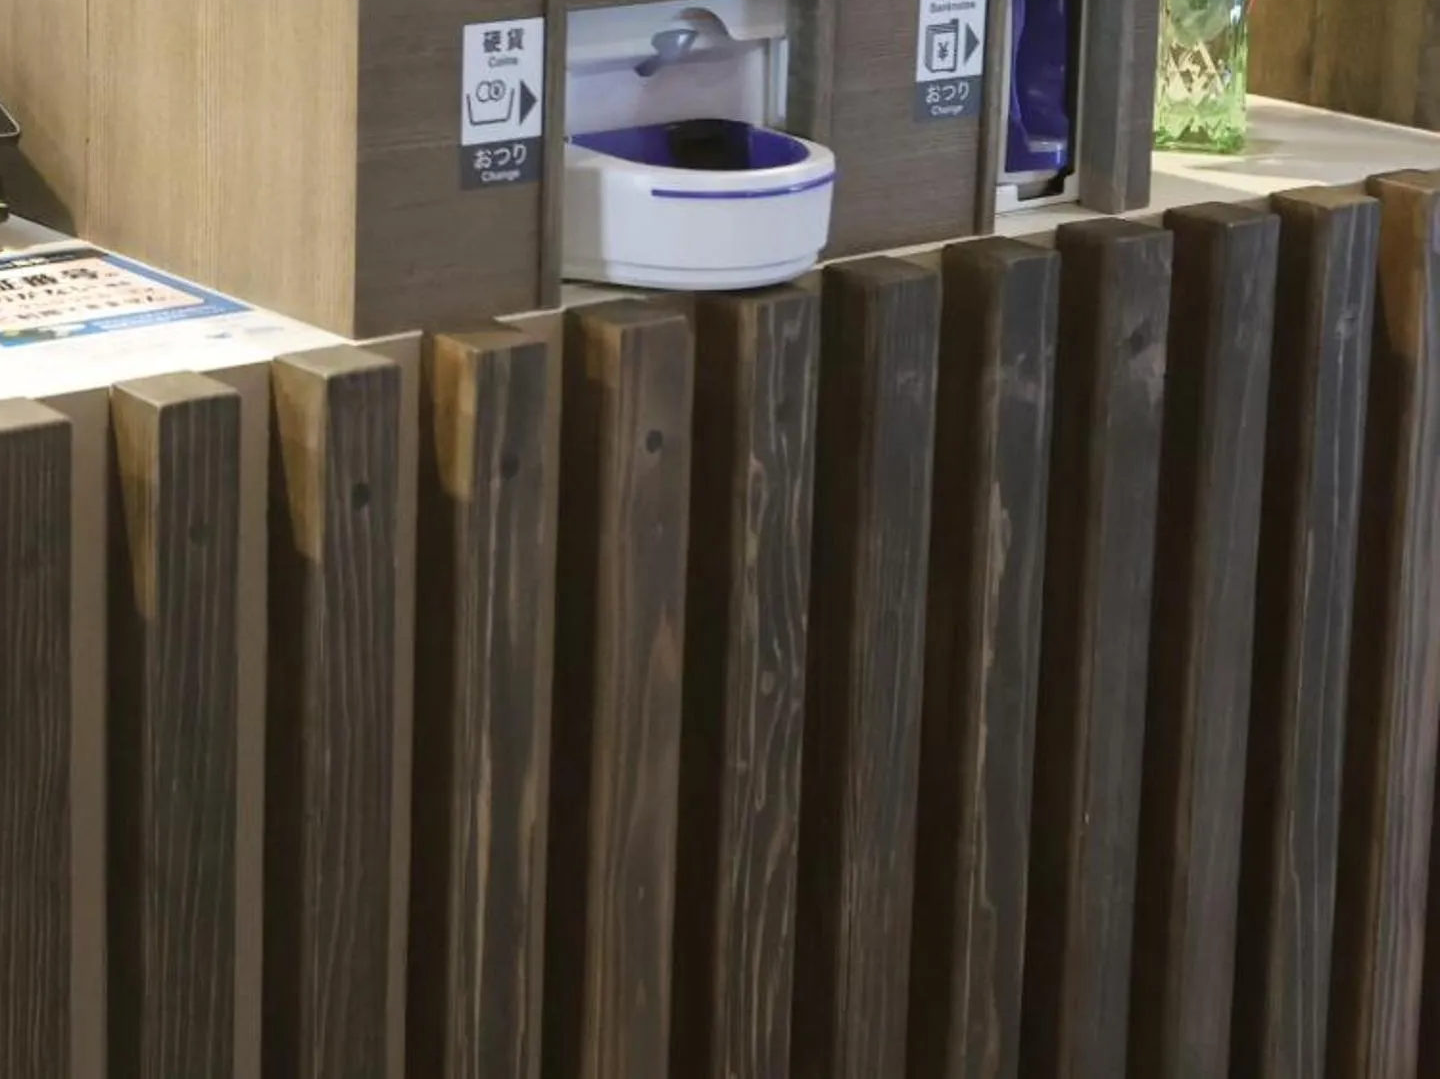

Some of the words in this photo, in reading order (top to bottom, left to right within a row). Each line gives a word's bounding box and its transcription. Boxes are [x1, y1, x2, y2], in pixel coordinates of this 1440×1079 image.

[926, 81, 969, 104] おつり
[474, 144, 527, 169] おつり
